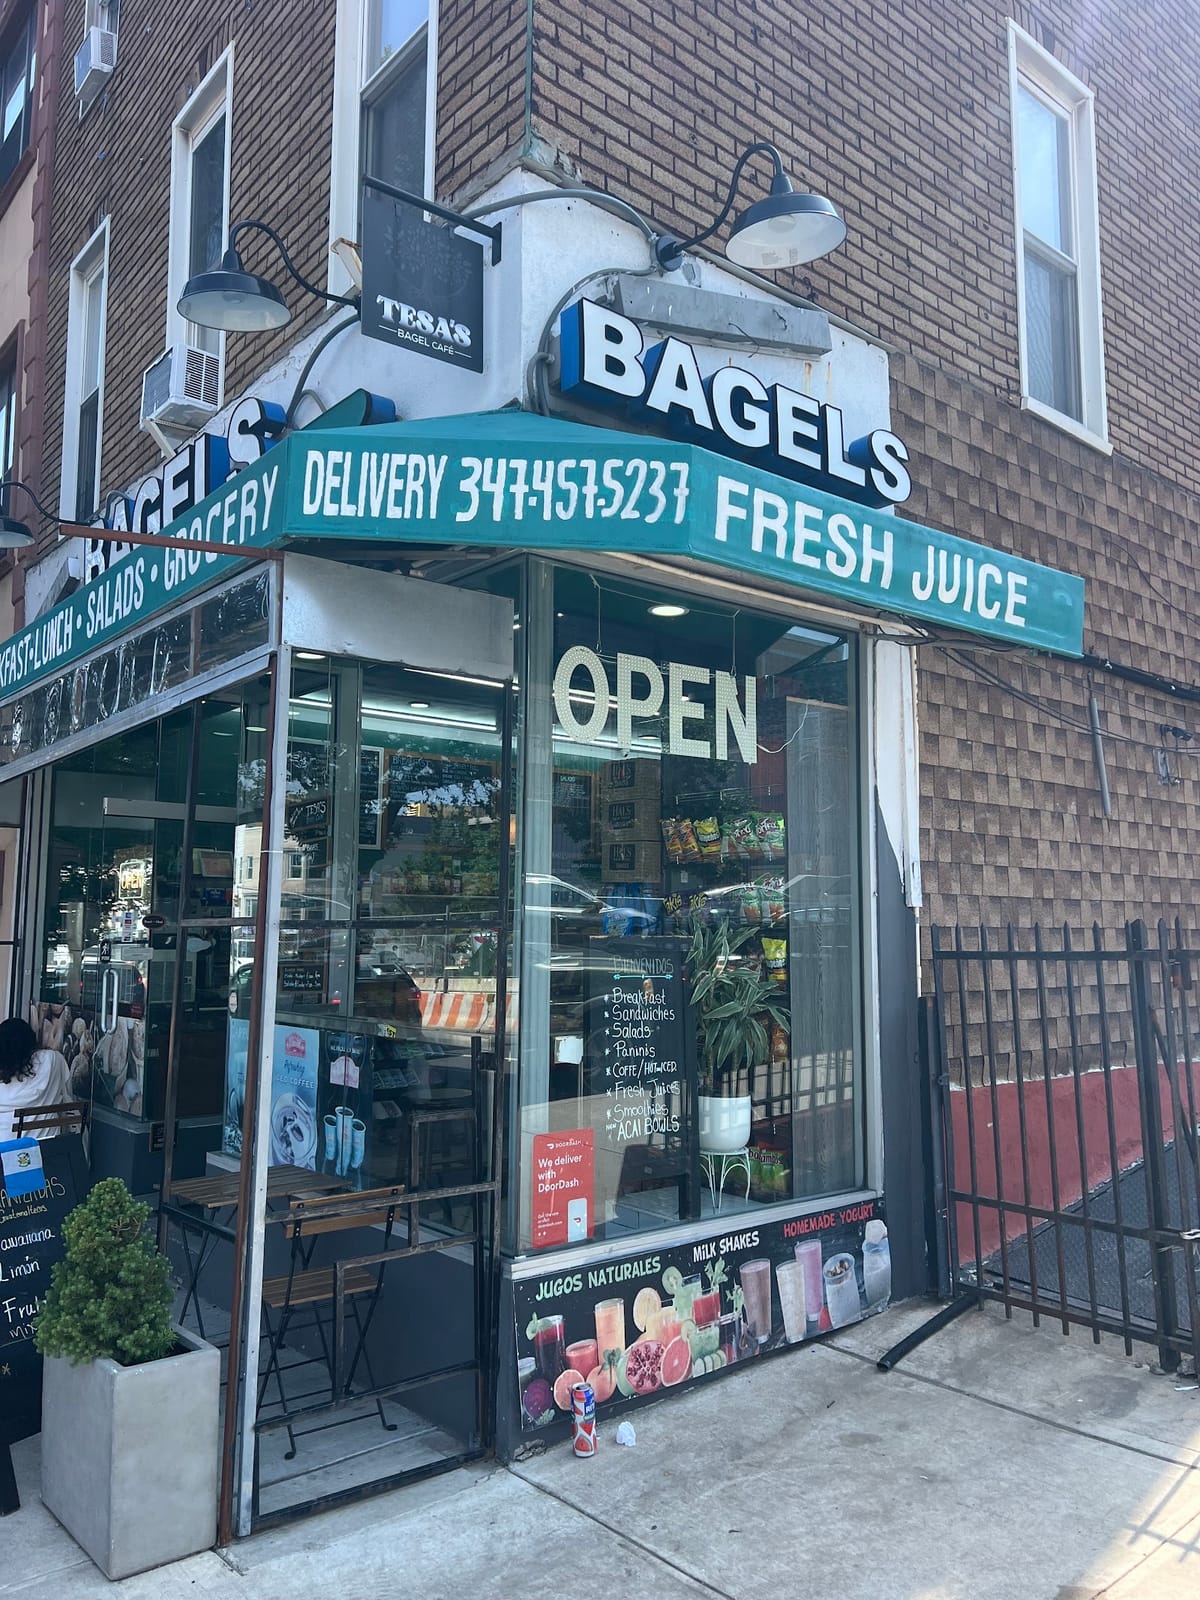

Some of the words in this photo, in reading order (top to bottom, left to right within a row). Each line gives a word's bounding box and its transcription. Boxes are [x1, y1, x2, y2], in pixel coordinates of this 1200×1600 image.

[376, 294, 472, 348] TESA'S
[397, 329, 430, 348] BAGEL
[431, 341, 454, 356] CAFÉ
[582, 298, 912, 503] BAGELS
[302, 449, 449, 519] DELIVERY
[86, 557, 146, 638] SALADS
[163, 465, 279, 591] GROCERY
[713, 475, 895, 590] FRESH
[911, 544, 1029, 628] JUICE
[553, 645, 758, 764] OPEN
[612, 987, 666, 1005] Breakfast
[612, 1004, 675, 1020] Sandwiches
[612, 1021, 652, 1039] Salads
[613, 1040, 656, 1058] Paninis
[615, 1081, 645, 1100] Fresh
[646, 1078, 680, 1098] Juices
[613, 1100, 669, 1122] Smoothies
[618, 1119, 642, 1141] ACAI
[644, 1115, 680, 1136] BOWLS
[538, 1158, 553, 1168] We
[554, 1154, 582, 1166] deliver
[538, 1169, 556, 1180] with
[538, 1178, 579, 1193] DoorDash
[535, 1273, 583, 1301] JUGOS
[588, 1256, 661, 1289] NATURALES
[719, 1231, 760, 1255] SHAKES
[783, 1213, 836, 1238] HOMEMADE
[839, 1202, 875, 1224] YOGURT
